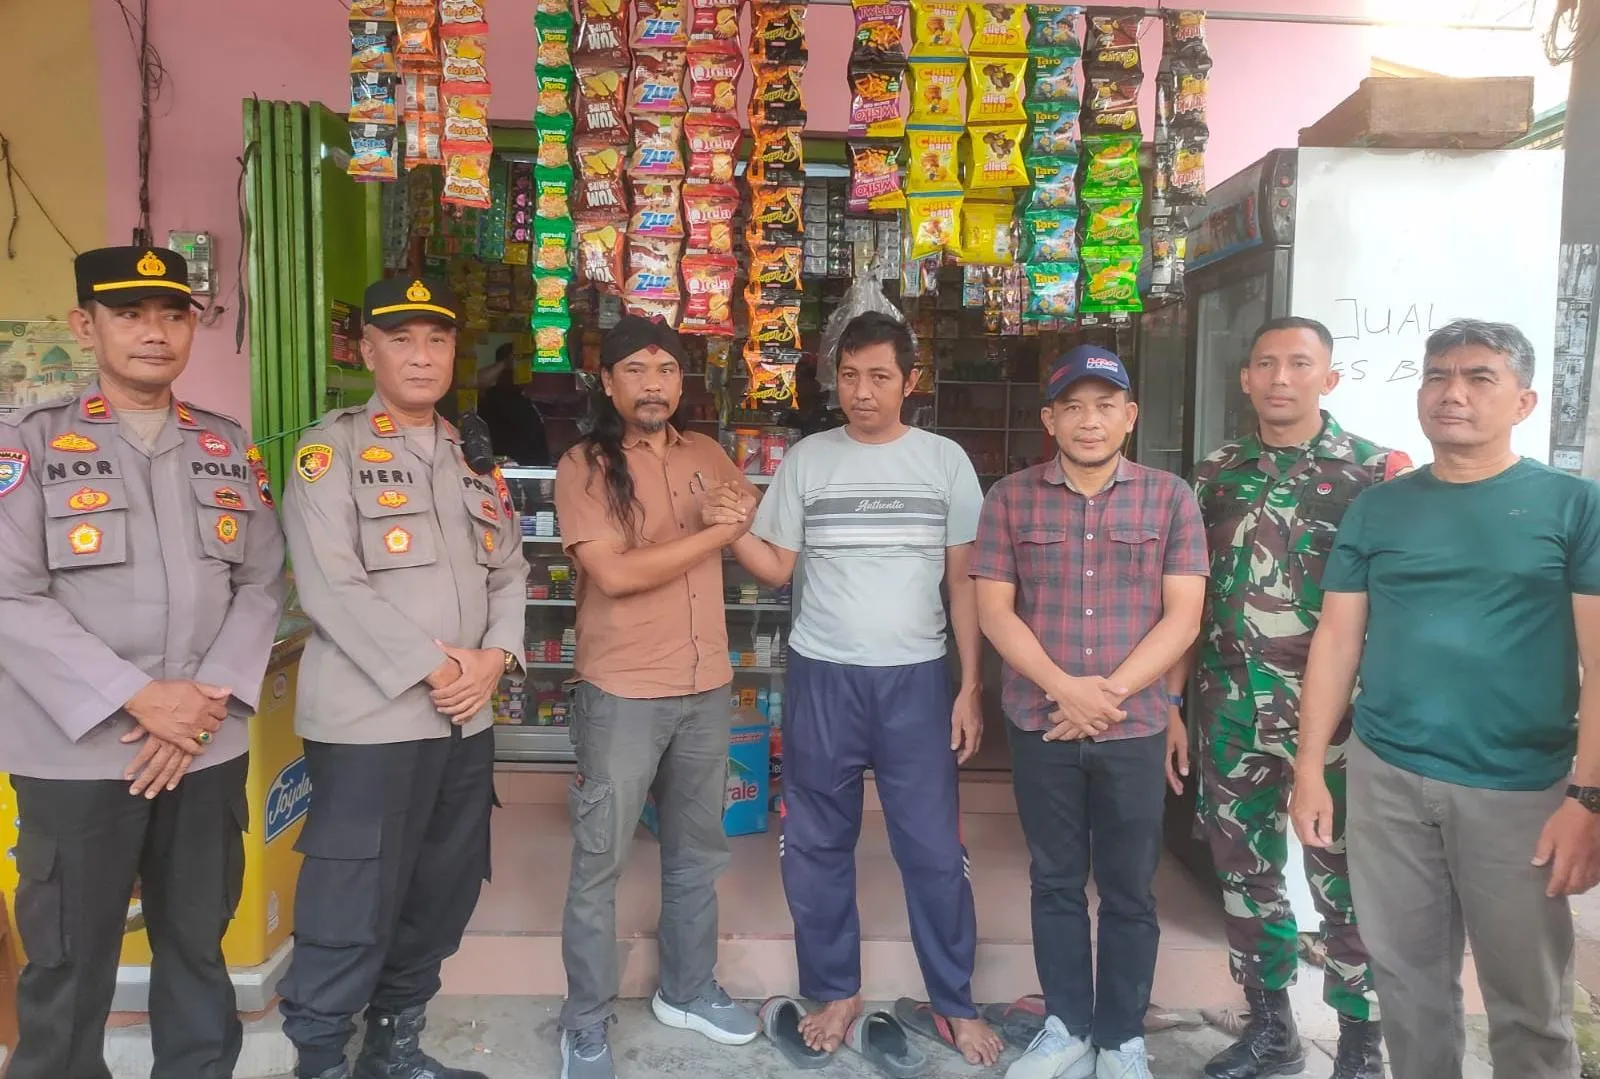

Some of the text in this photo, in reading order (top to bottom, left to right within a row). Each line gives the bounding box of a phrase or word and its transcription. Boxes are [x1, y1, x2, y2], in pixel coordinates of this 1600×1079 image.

[588, 35, 618, 50] YUM
[587, 110, 617, 129] YUM
[587, 189, 616, 207] YUM
[1333, 298, 1440, 340] JUAL
[1386, 360, 1424, 382] B
[47, 460, 113, 481] NOR
[192, 461, 247, 480] POLRI
[360, 469, 414, 484] HERI
[269, 772, 312, 825] Joyda
